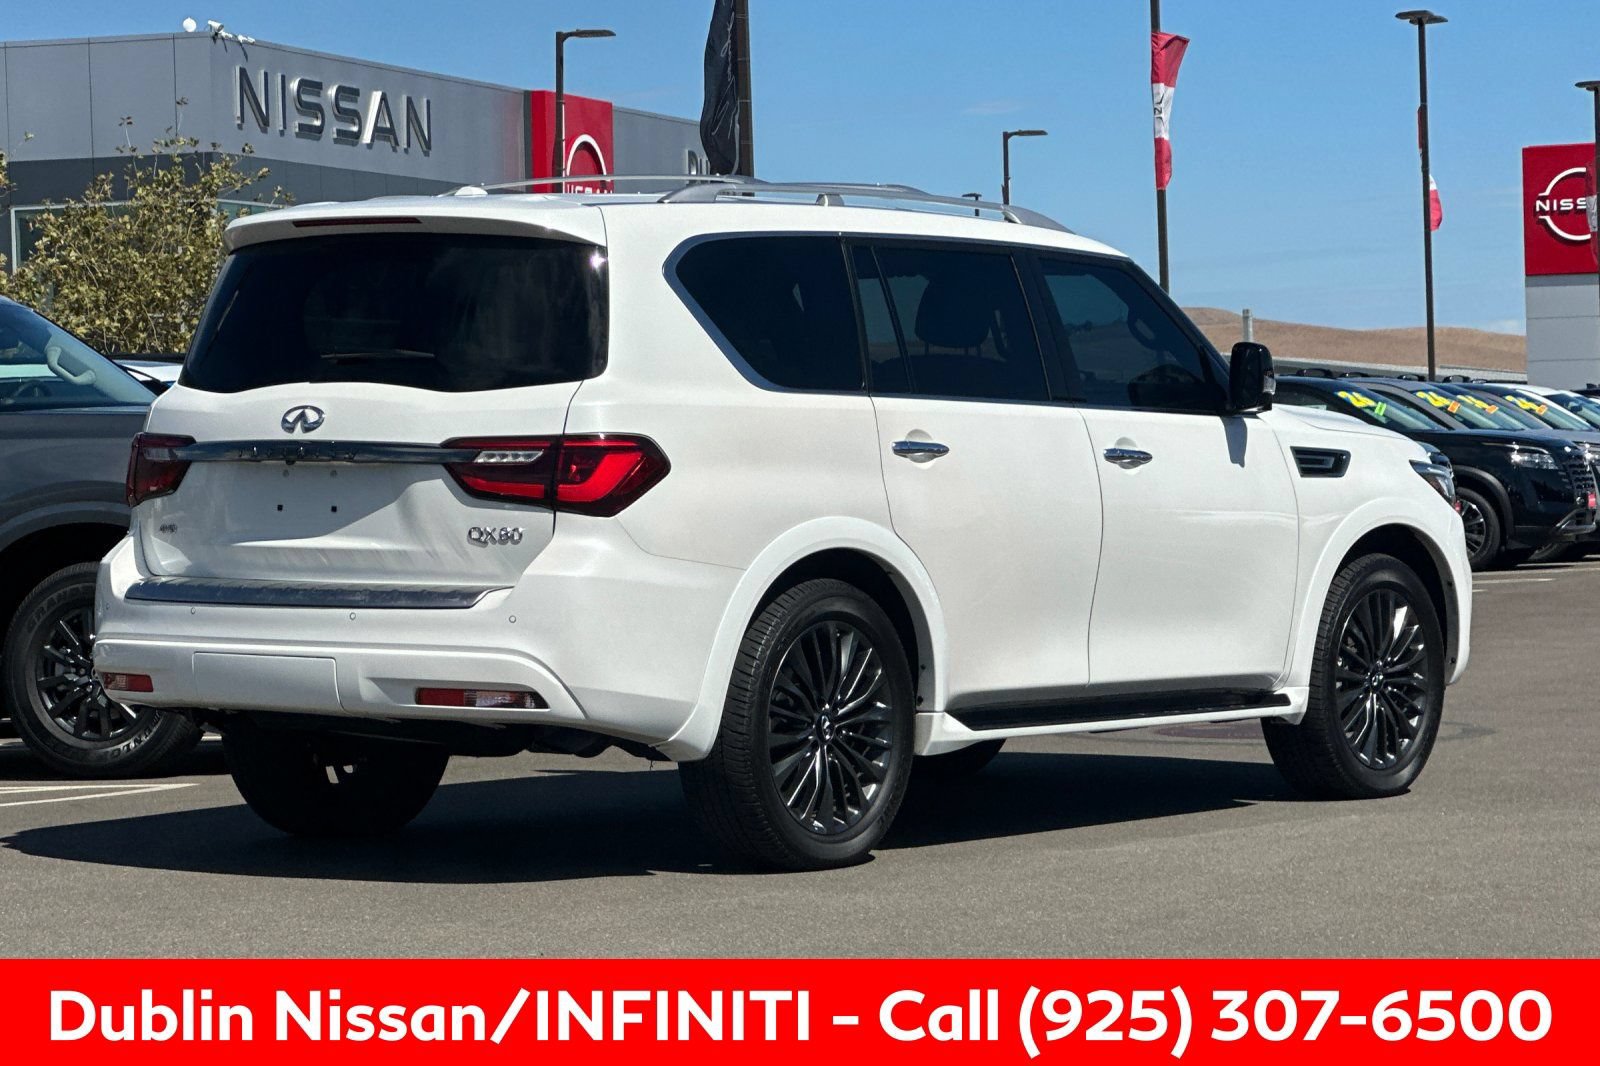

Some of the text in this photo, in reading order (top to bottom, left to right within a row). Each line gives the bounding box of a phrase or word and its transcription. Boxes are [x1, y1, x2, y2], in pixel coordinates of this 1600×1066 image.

[235, 66, 432, 154] NISSAN
[1535, 197, 1587, 212] NISS
[467, 526, 523, 546] QX80
